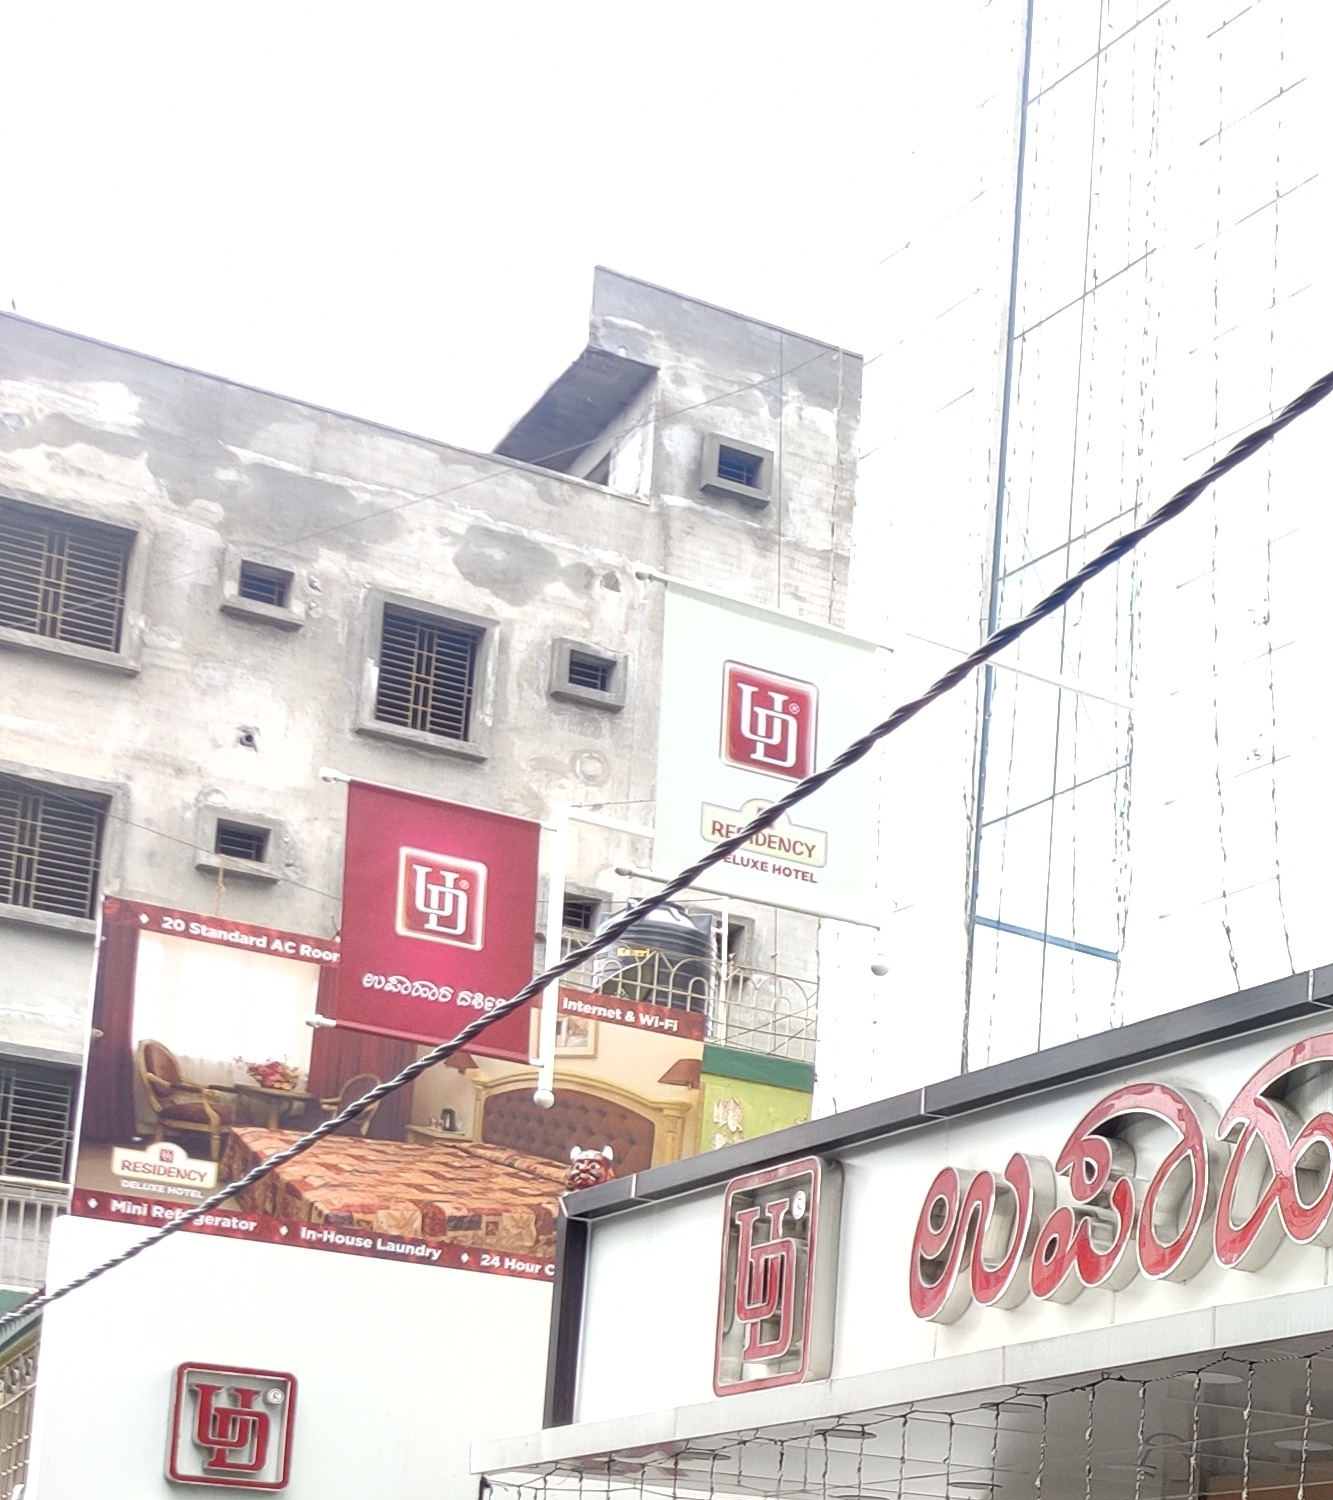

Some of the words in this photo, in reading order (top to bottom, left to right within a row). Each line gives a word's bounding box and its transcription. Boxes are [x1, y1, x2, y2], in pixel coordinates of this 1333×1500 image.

[710, 819, 817, 859] REIDENCY
[723, 853, 769, 873] ELUXE
[771, 863, 818, 884] HOTEL
[161, 916, 186, 932] 20
[189, 922, 268, 949] Standard
[270, 938, 297, 954] AC
[563, 996, 622, 1021] Internet
[625, 1010, 636, 1023] &
[639, 1012, 678, 1033] Wi-Fi
[120, 1159, 208, 1183] RESIDENCY
[120, 1179, 165, 1194] DELUXE
[166, 1186, 204, 1199] HOTEL
[110, 1199, 148, 1217] Mini
[300, 1226, 374, 1250] In-House
[376, 1237, 442, 1262] Laundry
[480, 1253, 501, 1268] 24
[503, 1259, 542, 1274] Hour
